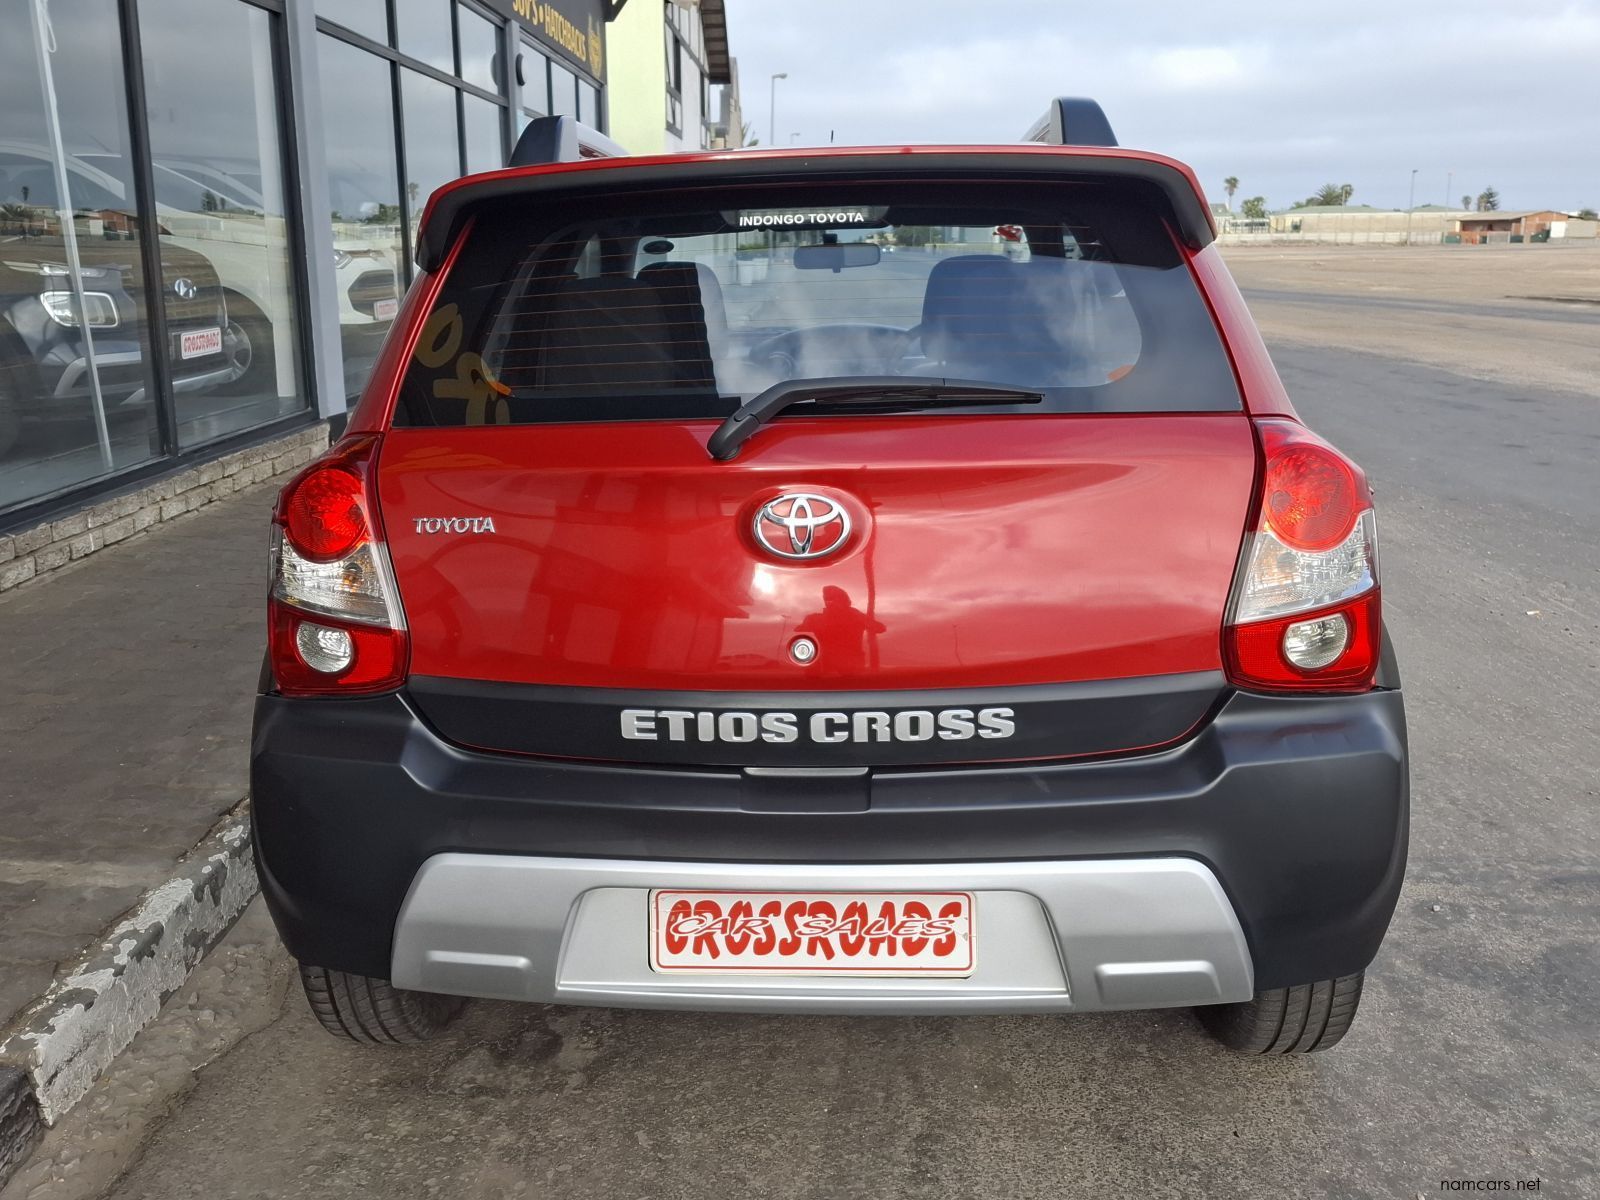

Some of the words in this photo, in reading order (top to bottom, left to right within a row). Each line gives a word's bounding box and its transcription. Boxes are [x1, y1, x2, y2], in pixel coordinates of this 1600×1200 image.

[544, 3, 586, 62] HATCHBACKS
[739, 214, 805, 227] INDONGO
[808, 212, 865, 224] TOYOTA
[412, 516, 496, 534] TOYOTA
[620, 709, 799, 744] ETIOS
[809, 707, 1016, 743] CROSS
[665, 899, 962, 961] CROSSROADS
[670, 915, 772, 937] CAR
[795, 917, 956, 939] SALES
